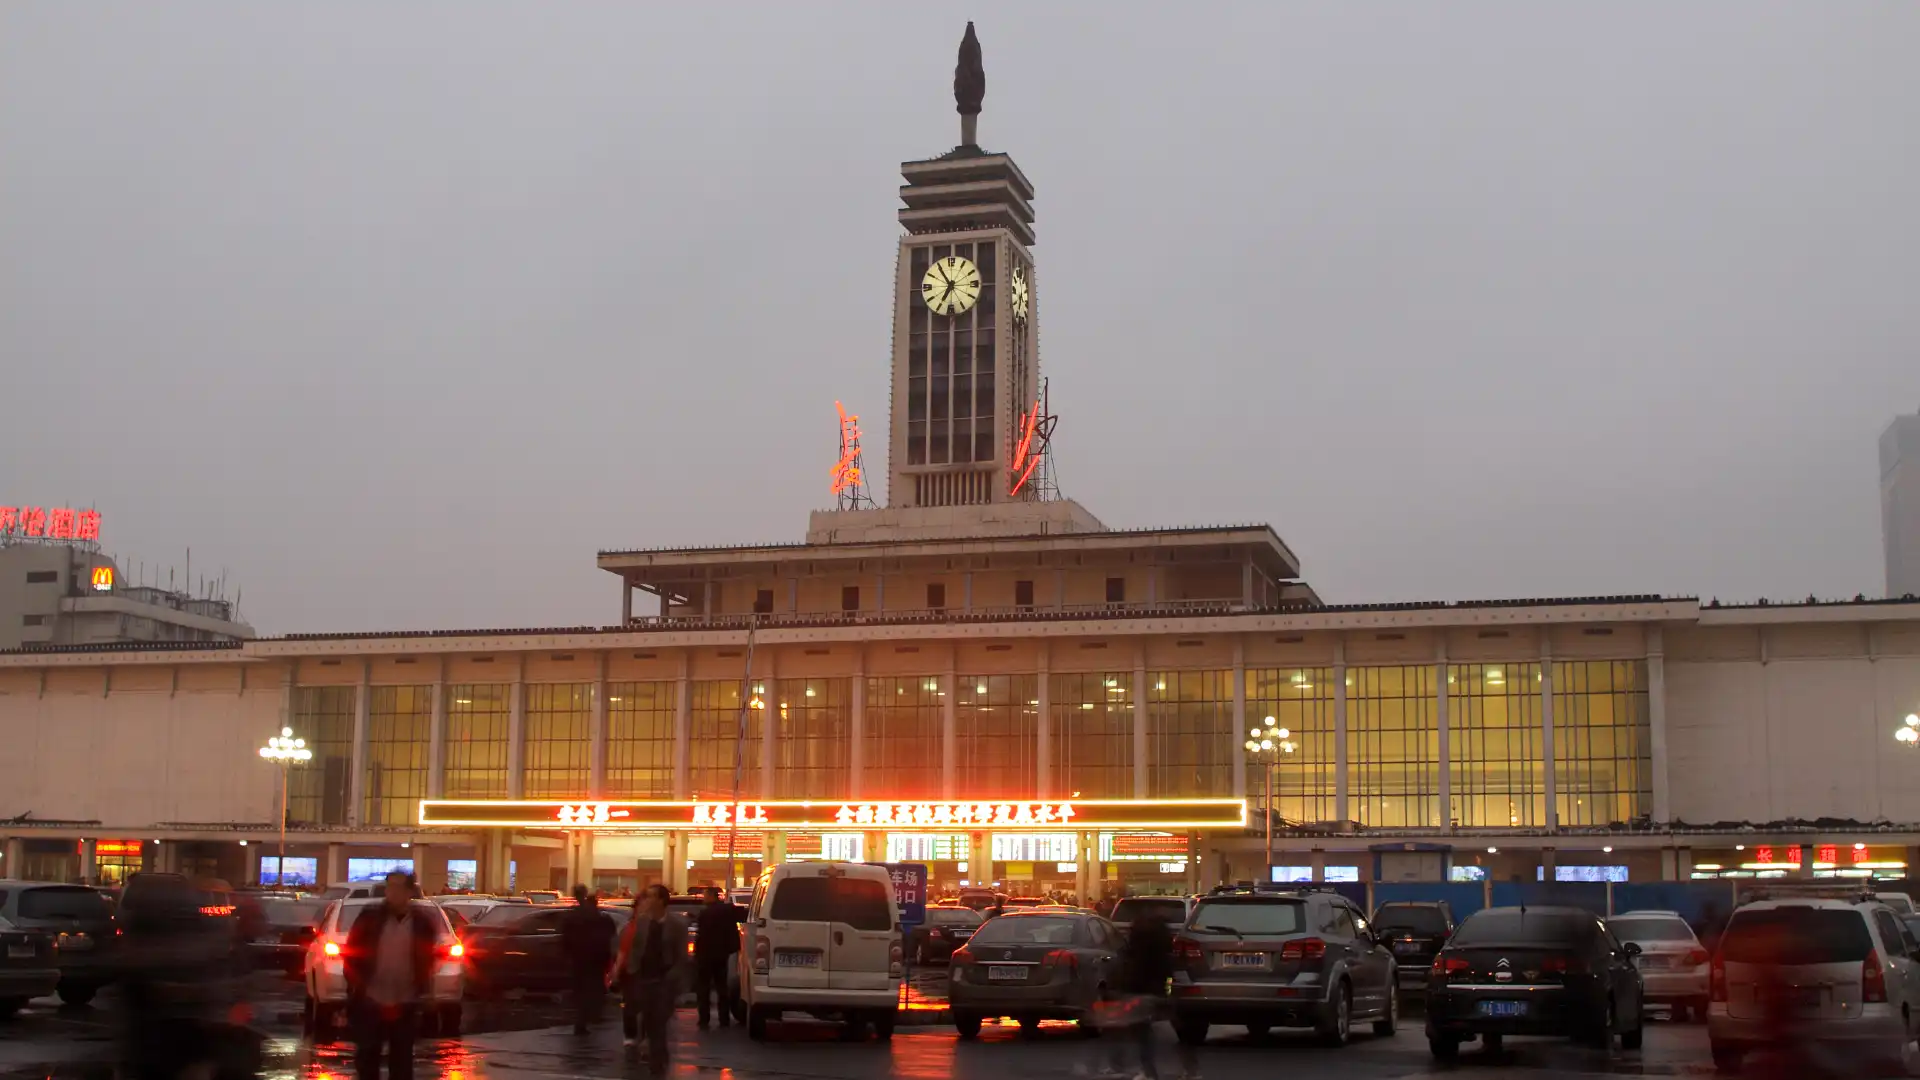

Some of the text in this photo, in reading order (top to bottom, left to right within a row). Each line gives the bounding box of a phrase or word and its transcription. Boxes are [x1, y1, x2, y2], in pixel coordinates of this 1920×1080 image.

[557, 804, 630, 823] 安全第一
[692, 804, 769, 823] 服务至上
